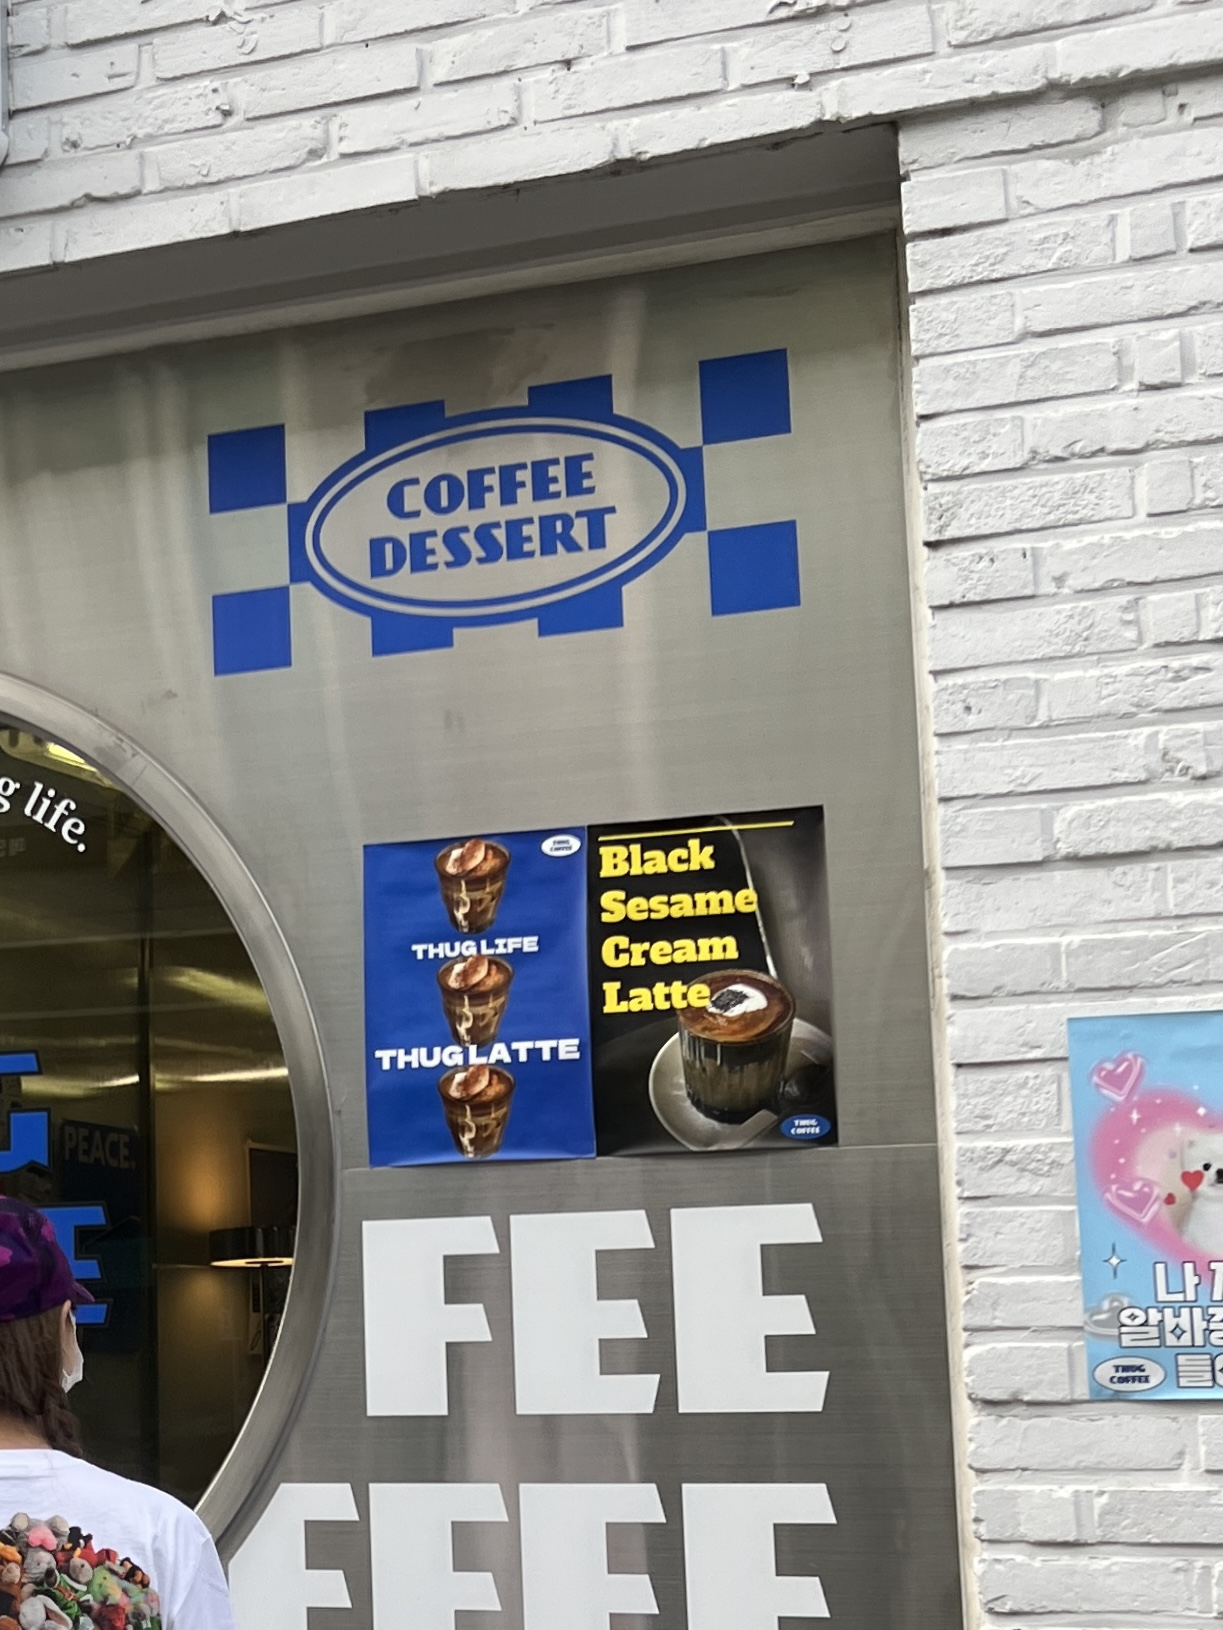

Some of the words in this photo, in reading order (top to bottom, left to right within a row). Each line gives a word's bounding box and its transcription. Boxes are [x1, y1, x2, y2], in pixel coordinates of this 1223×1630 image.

[386, 453, 597, 520] COFFEE
[369, 506, 617, 580] DESSERT
[23, 781, 87, 853] life.
[598, 838, 716, 878] Black
[599, 888, 758, 924] Sesame
[412, 941, 476, 960] THUG
[480, 936, 539, 955] LIFE
[601, 934, 739, 969] Cream
[602, 980, 712, 1014] Latte
[374, 1045, 464, 1071] THUG
[468, 1038, 581, 1067] LATTE
